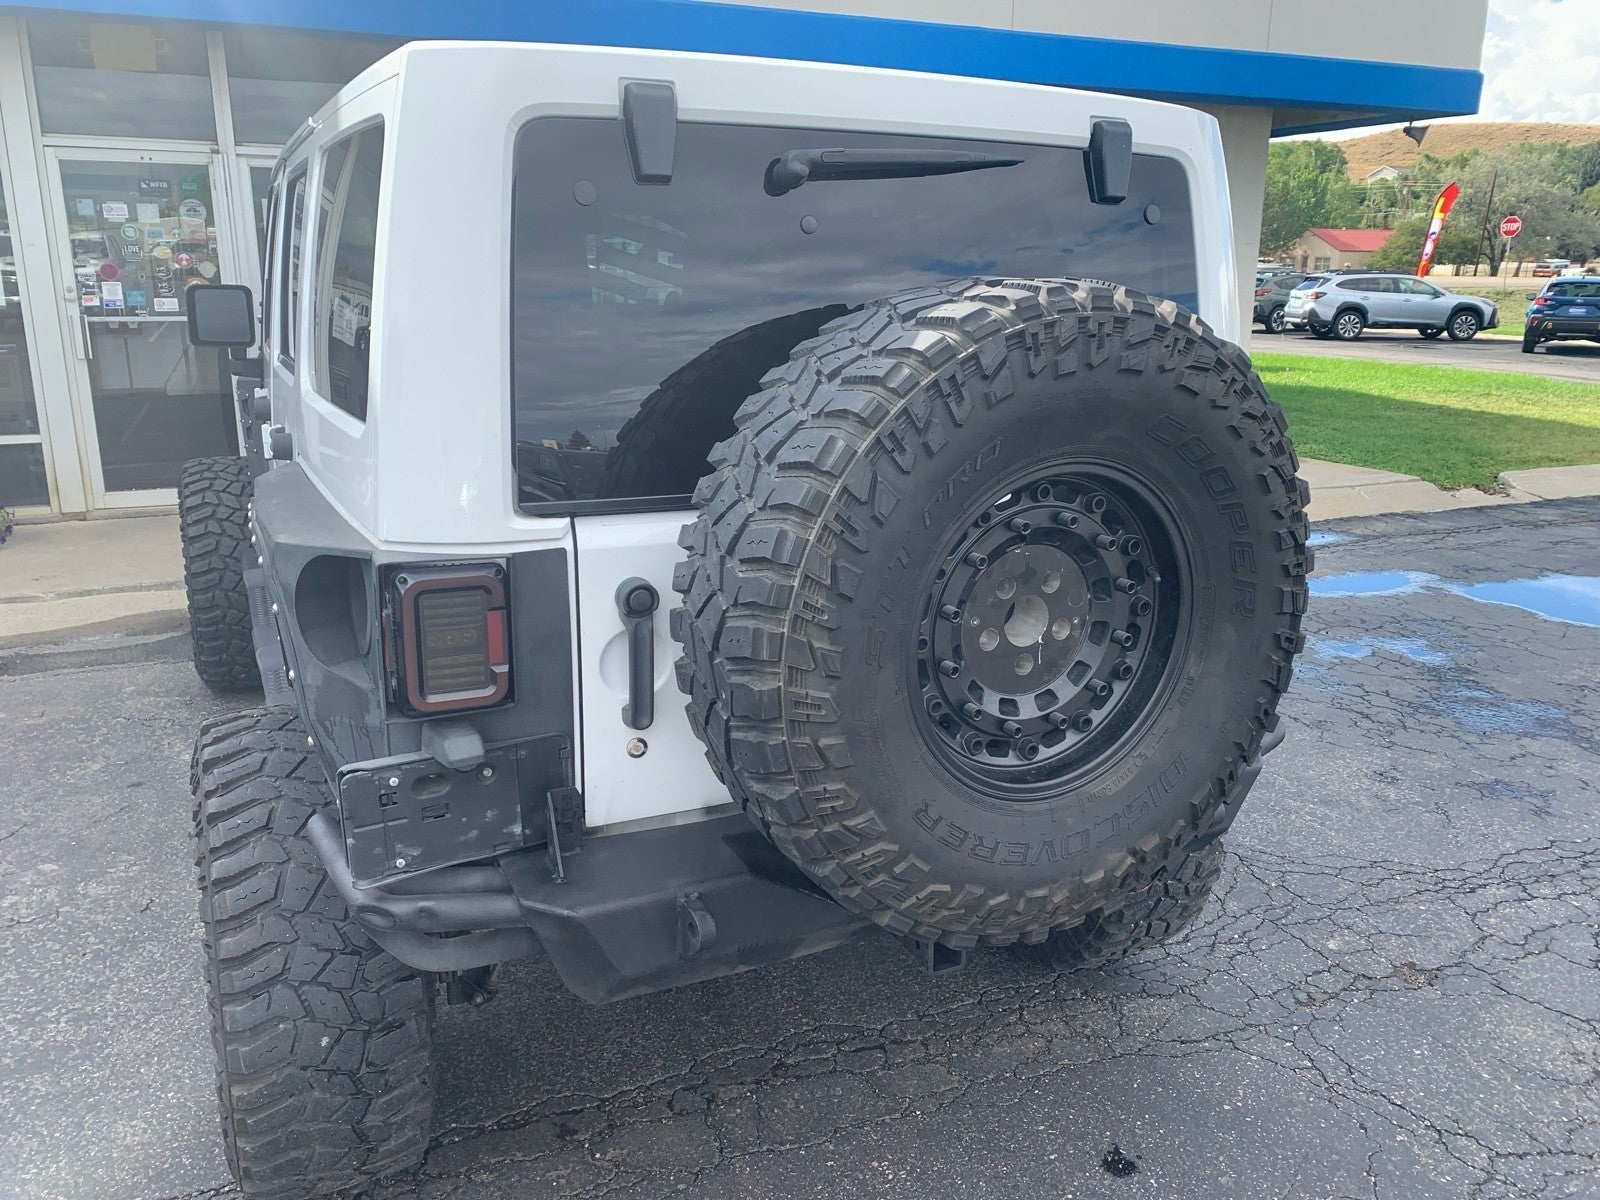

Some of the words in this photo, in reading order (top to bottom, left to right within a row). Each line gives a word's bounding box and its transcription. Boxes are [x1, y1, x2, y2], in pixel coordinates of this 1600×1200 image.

[124, 245, 140, 253] LOVE
[1502, 222, 1520, 231] STOP
[1145, 414, 1257, 618] COOPER
[912, 751, 1192, 866] DISCOVERER
